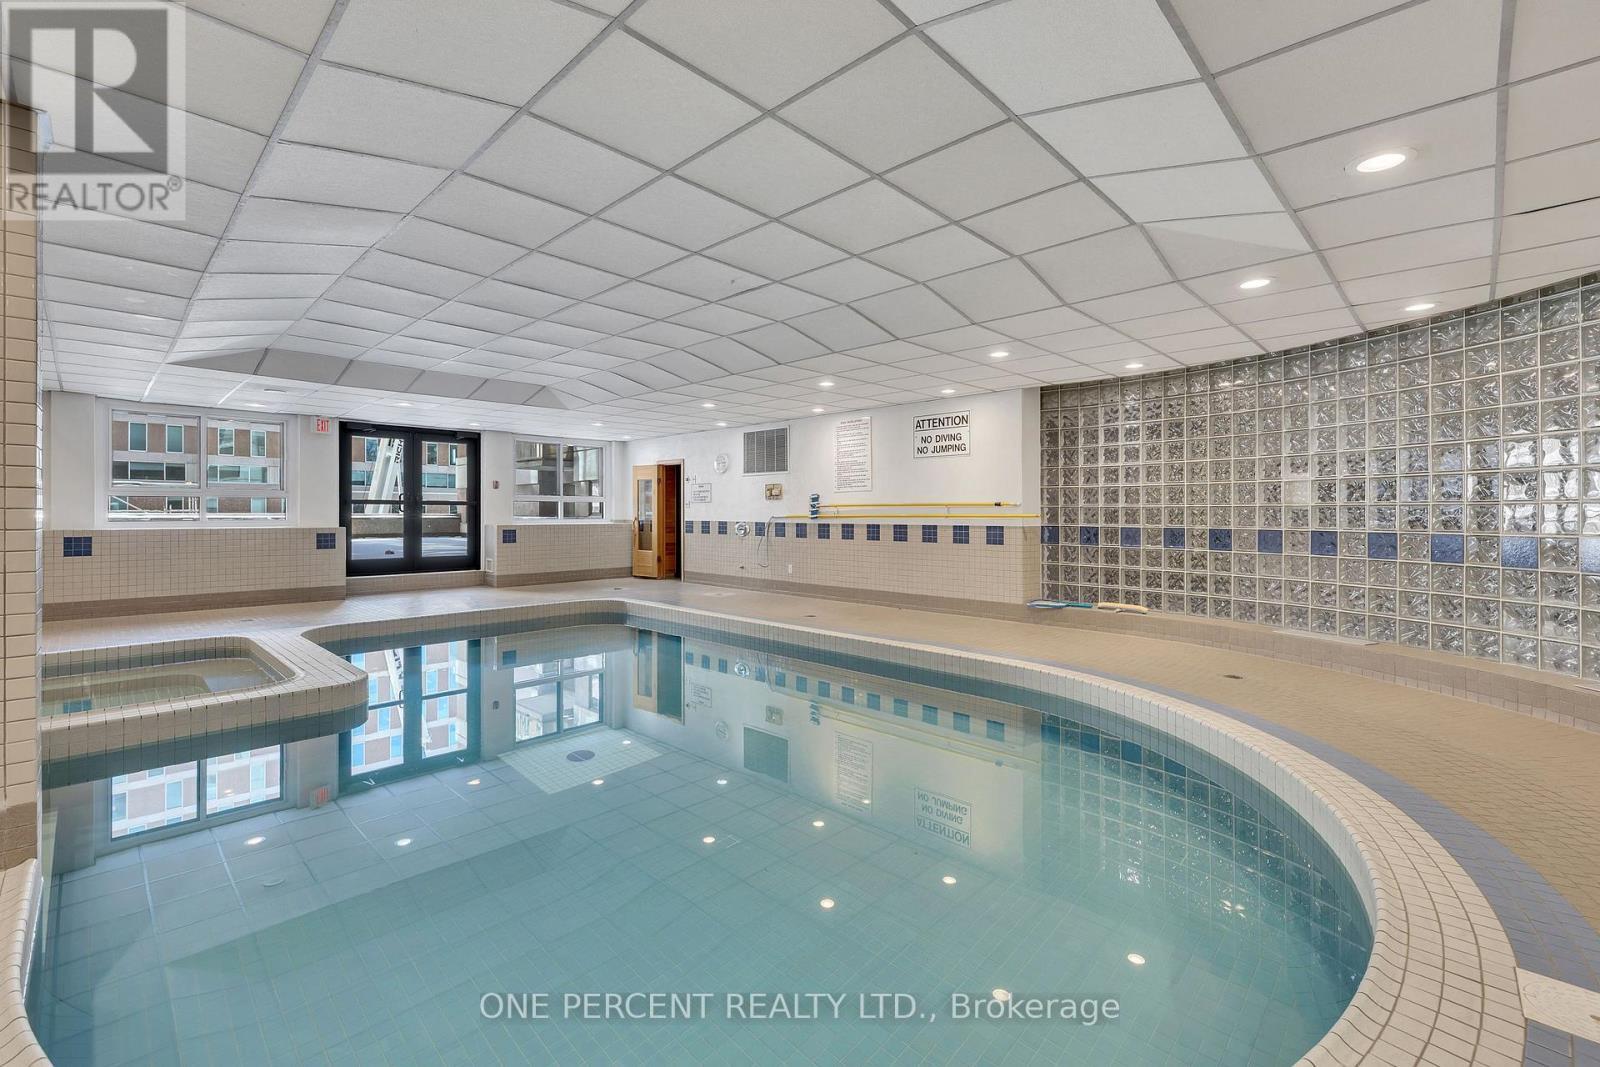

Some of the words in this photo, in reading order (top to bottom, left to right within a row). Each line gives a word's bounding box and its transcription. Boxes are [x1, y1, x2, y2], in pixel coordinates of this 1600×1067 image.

[316, 418, 329, 432] EXIT
[915, 414, 968, 429] ATTENTION
[921, 435, 933, 444] NO
[935, 433, 962, 443] DIVING
[917, 446, 929, 455] NO
[931, 443, 966, 454] JUMPING
